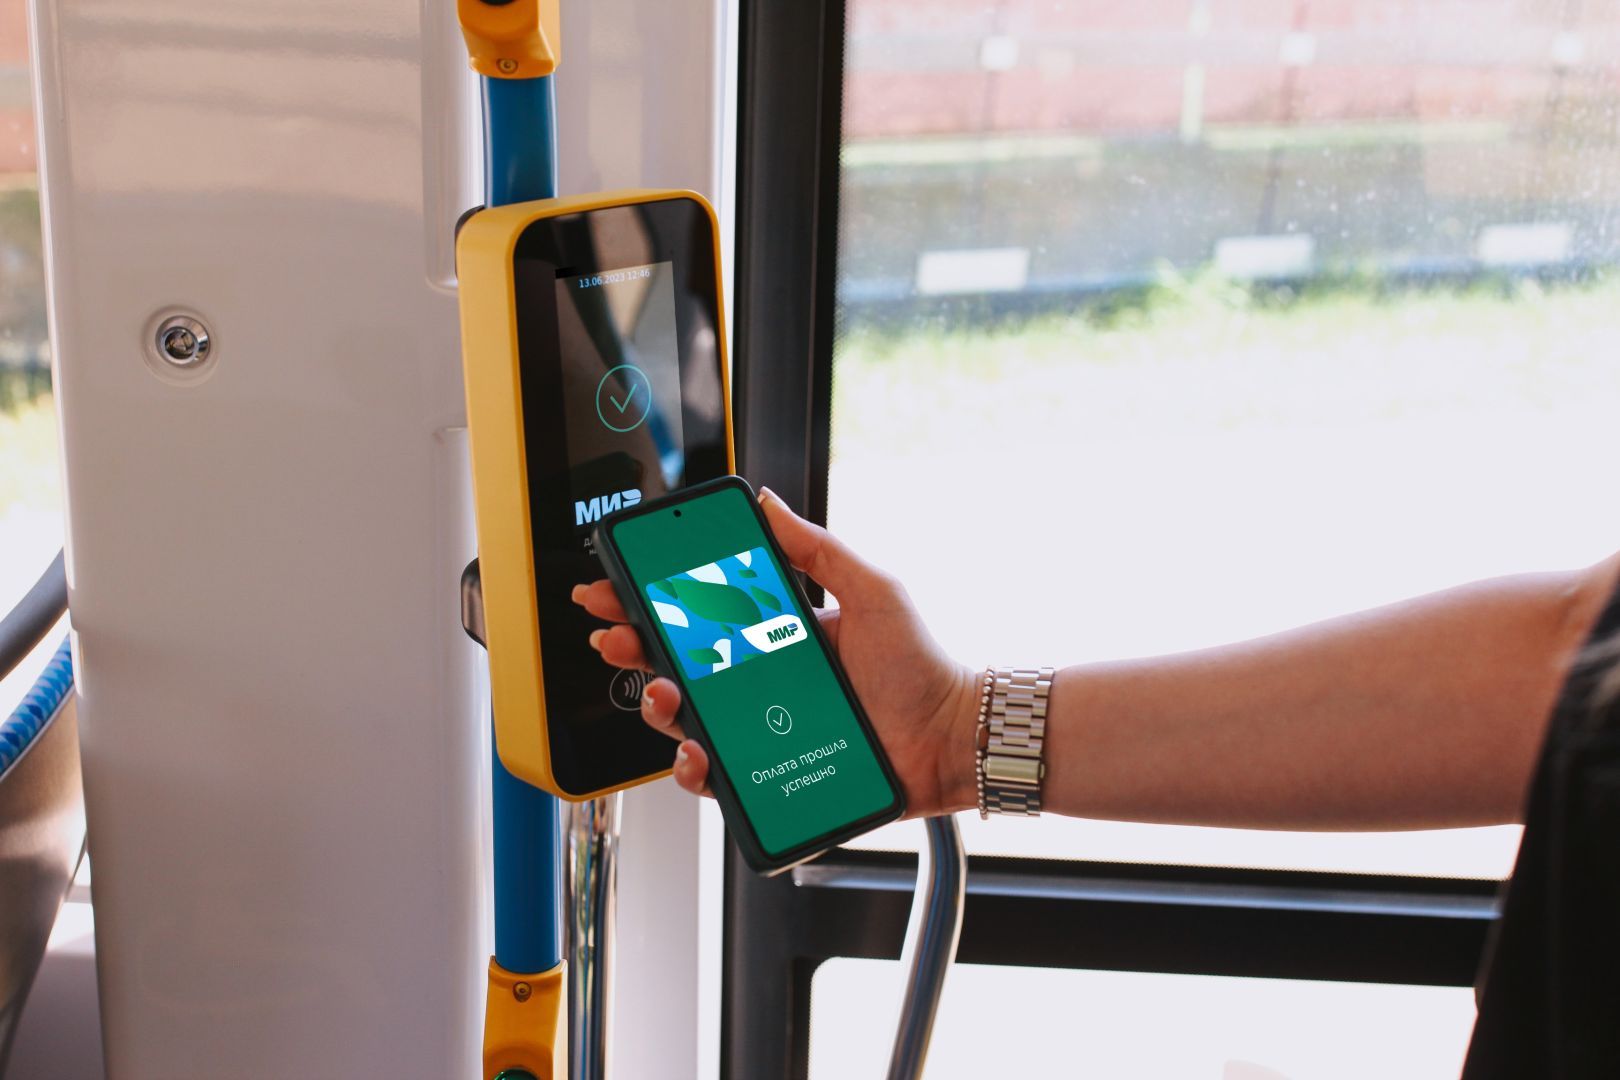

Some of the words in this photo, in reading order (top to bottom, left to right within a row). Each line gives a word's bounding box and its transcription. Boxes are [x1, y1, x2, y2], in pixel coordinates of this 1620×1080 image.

[579, 272, 625, 288] 13.06.2023
[627, 268, 650, 281] 12:46
[767, 622, 799, 643] МИР
[752, 759, 798, 784] Оплата
[799, 739, 848, 765] прошла
[781, 765, 836, 797] успешно
